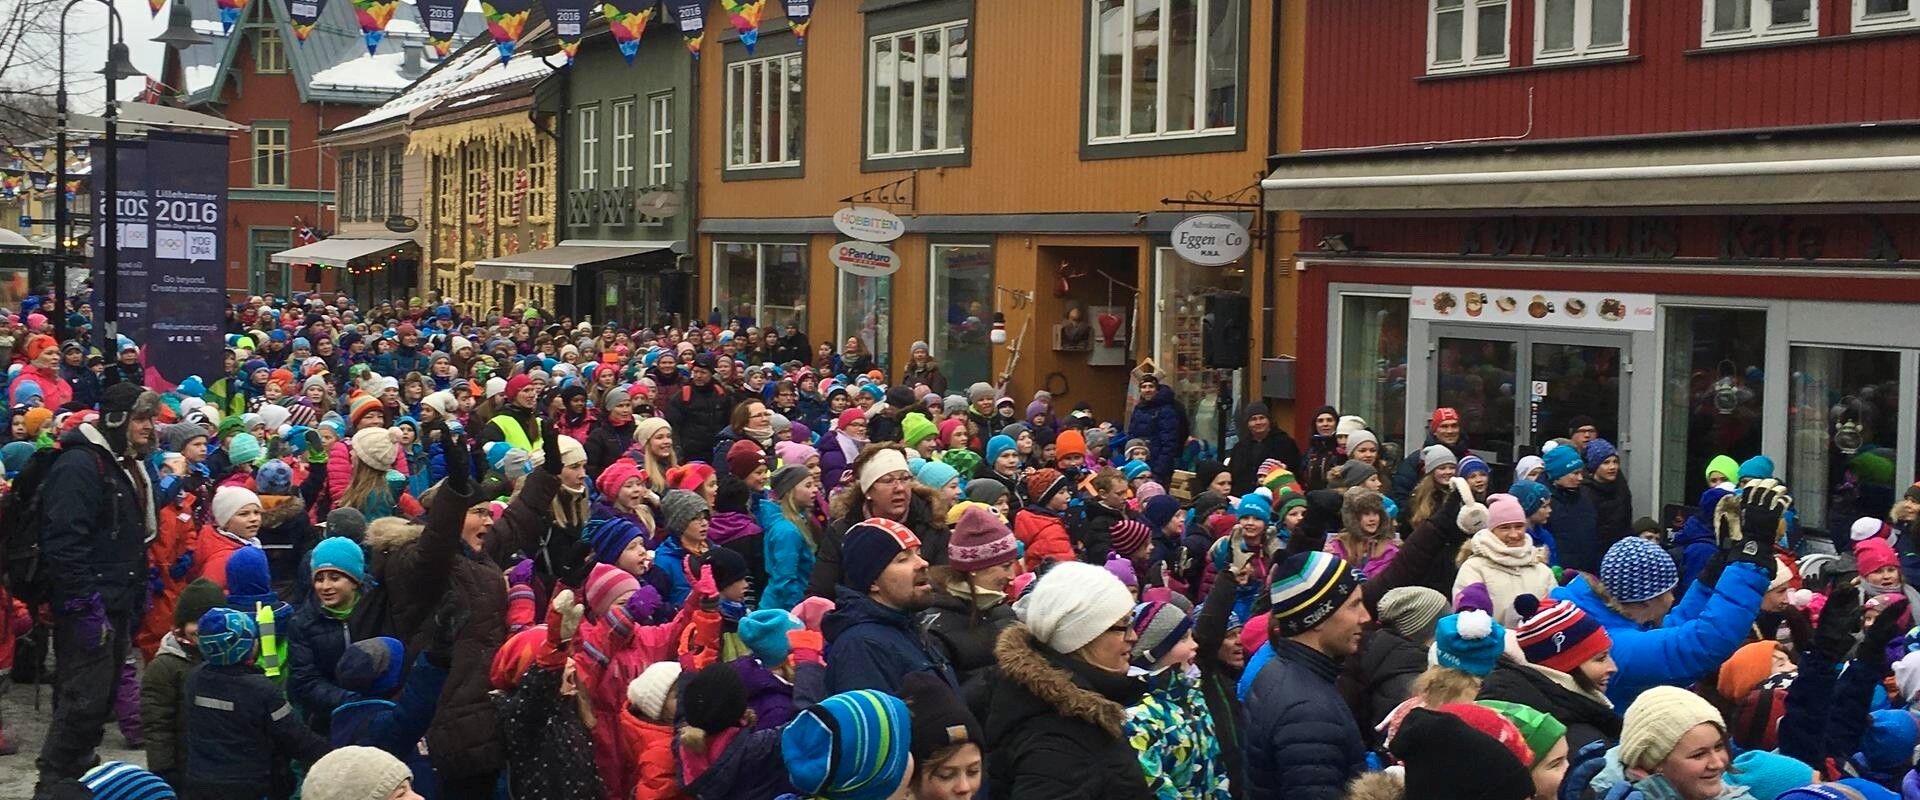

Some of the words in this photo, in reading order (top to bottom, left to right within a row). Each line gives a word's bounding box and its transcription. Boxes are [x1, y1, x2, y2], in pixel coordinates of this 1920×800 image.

[429, 9, 455, 19] 2016
[557, 12, 580, 21] 2016
[678, 7, 701, 18] 2016
[155, 189, 218, 201] Lillehammer
[155, 199, 218, 224] 2016
[841, 213, 898, 231] HOBBITEN
[1179, 231, 1216, 250] Eggen
[1226, 232, 1242, 246] Co
[191, 246, 211, 255] DNA
[848, 247, 891, 263] Panduro
[163, 274, 176, 283] Go
[151, 283, 177, 293] Create
